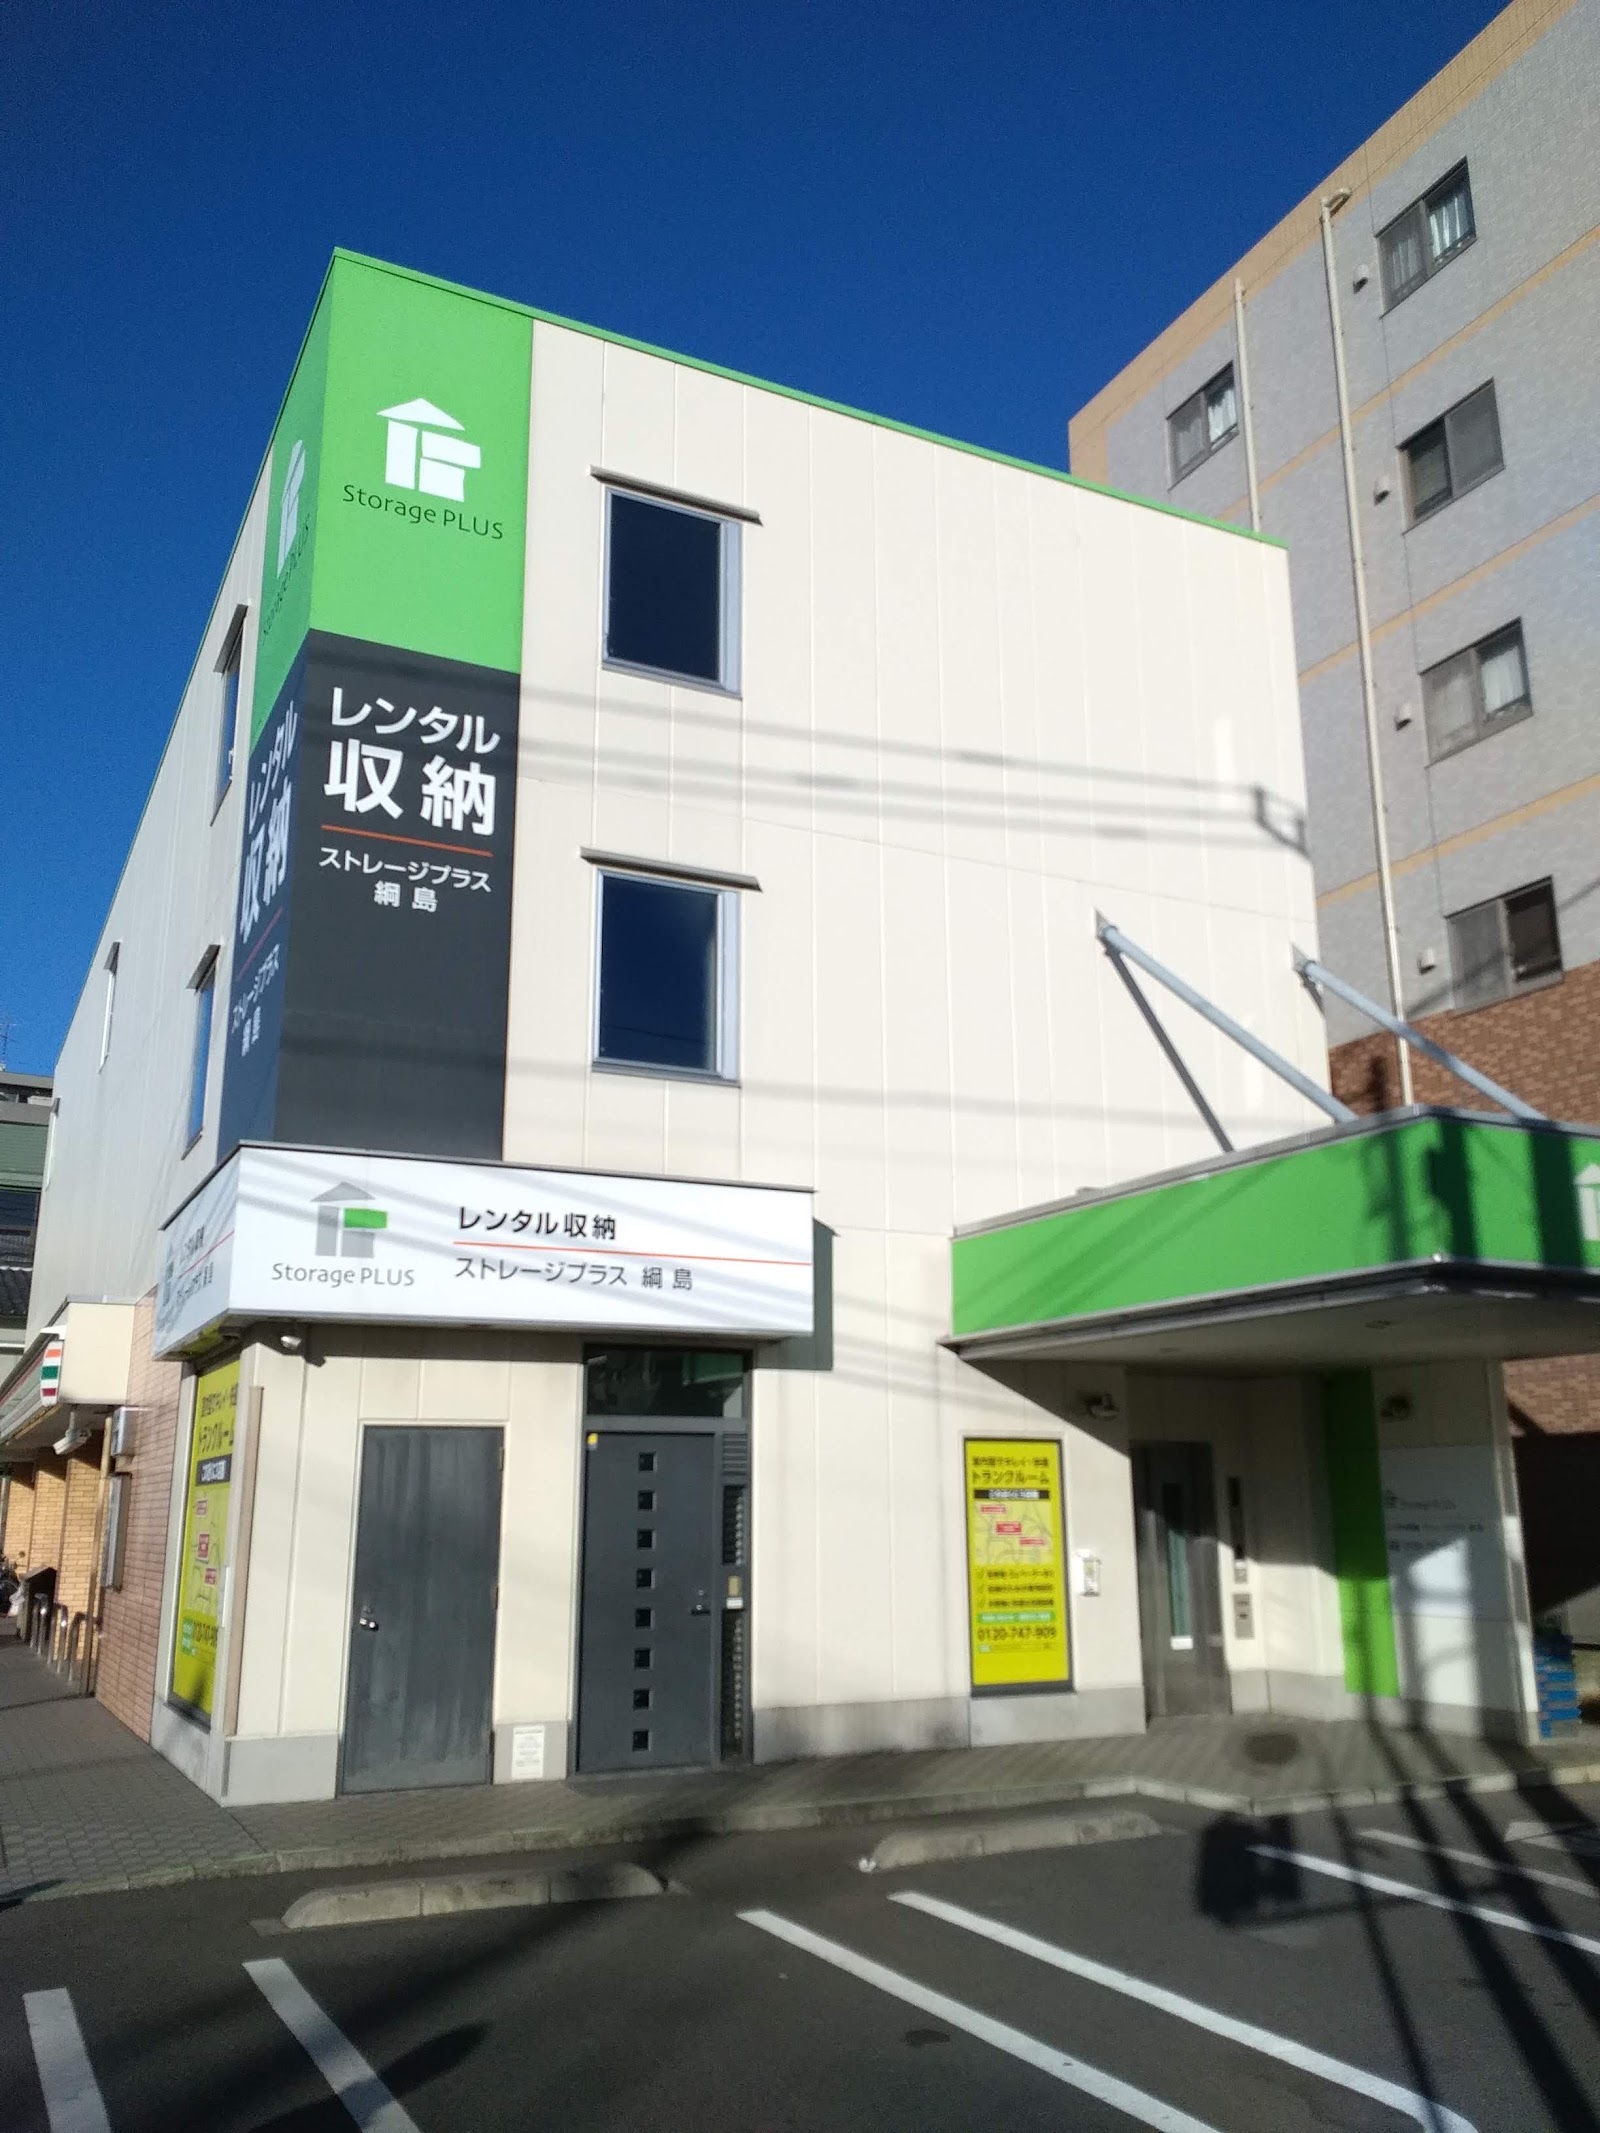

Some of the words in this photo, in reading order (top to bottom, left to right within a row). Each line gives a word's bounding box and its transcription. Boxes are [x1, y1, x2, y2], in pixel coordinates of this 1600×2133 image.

[342, 484, 437, 524] Storage
[443, 509, 504, 540] PLUS
[331, 687, 500, 754] レンタル
[324, 738, 496, 836] 収納
[319, 847, 492, 892] ストレージプラス
[458, 1206, 616, 1240] レンタル収納
[271, 1262, 355, 1288] Storage
[360, 1267, 415, 1286] PLUS
[455, 1257, 628, 1285] ストレージプラス
